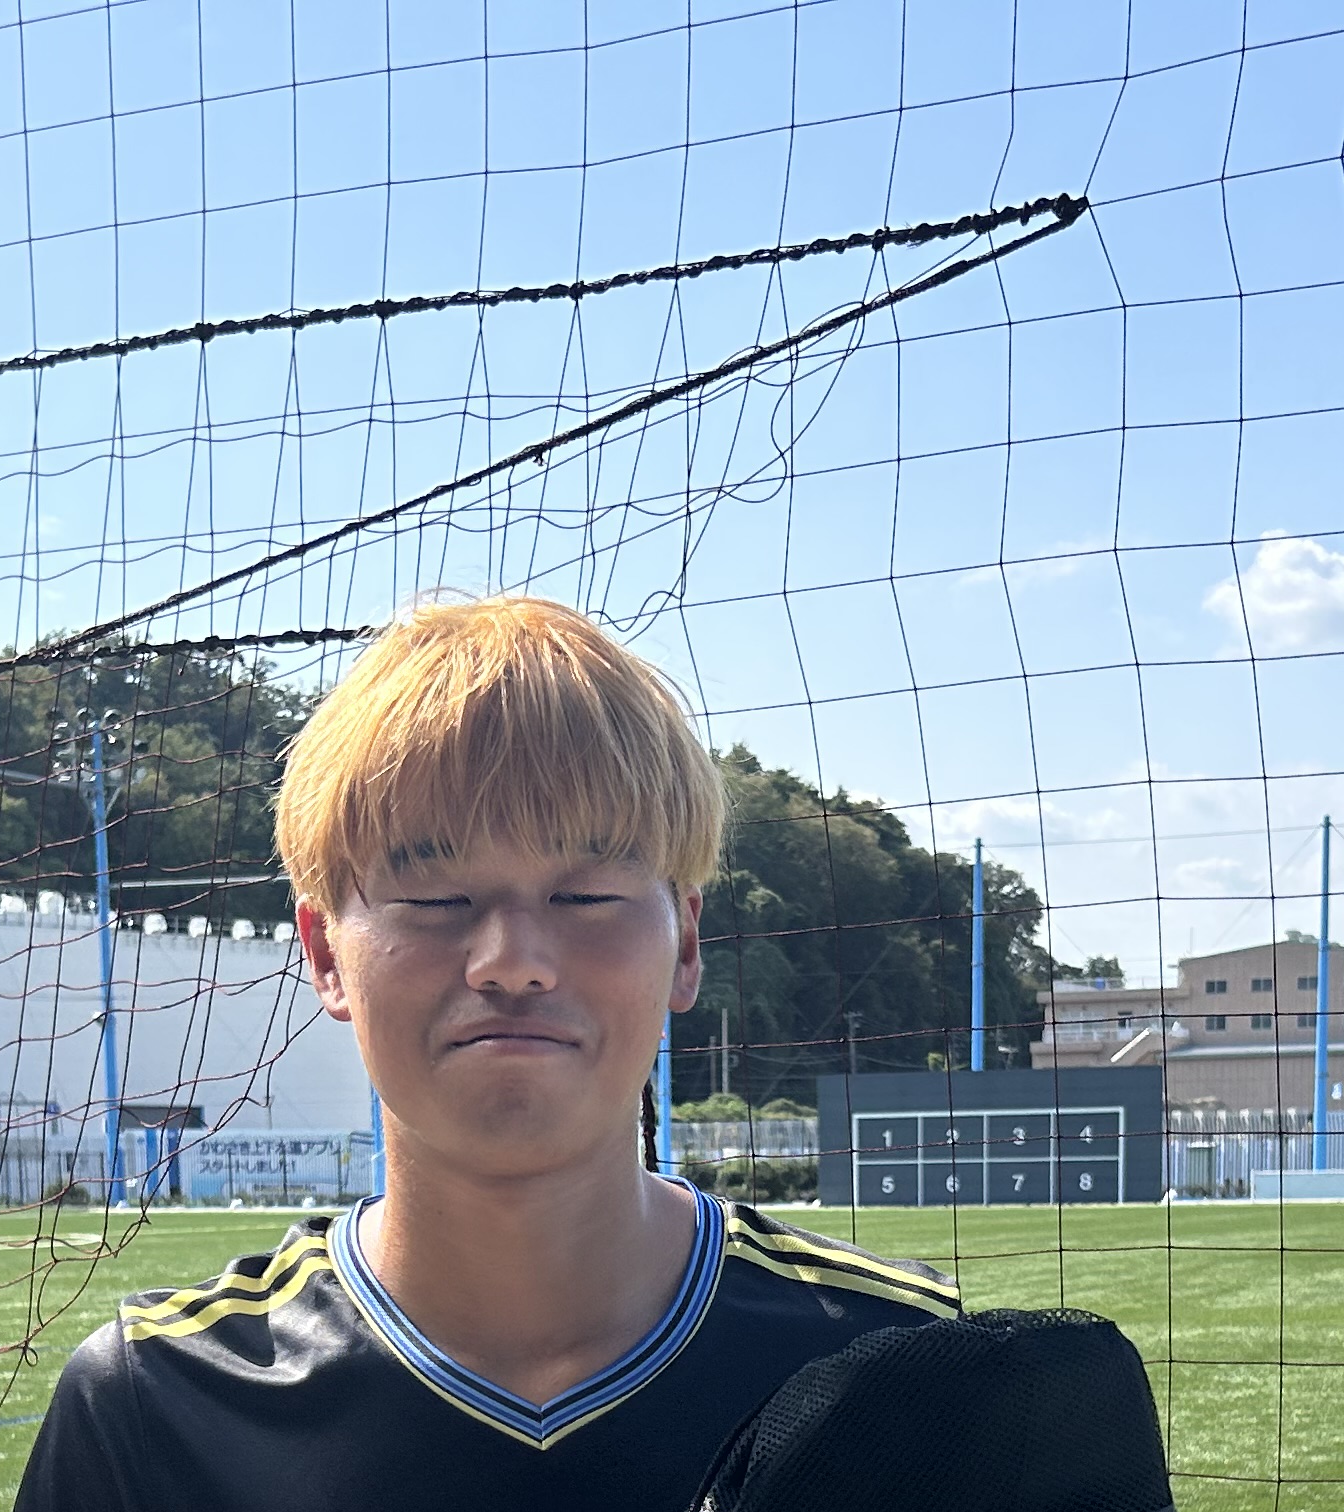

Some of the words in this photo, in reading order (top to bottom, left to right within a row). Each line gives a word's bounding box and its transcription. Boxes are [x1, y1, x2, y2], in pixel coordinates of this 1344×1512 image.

[882, 1129, 893, 1148] 1
[1079, 1125, 1093, 1144] 4
[881, 1175, 895, 1194] 5
[945, 1174, 960, 1193] 6
[1012, 1173, 1025, 1192] 7
[1079, 1172, 1093, 1191] 8
